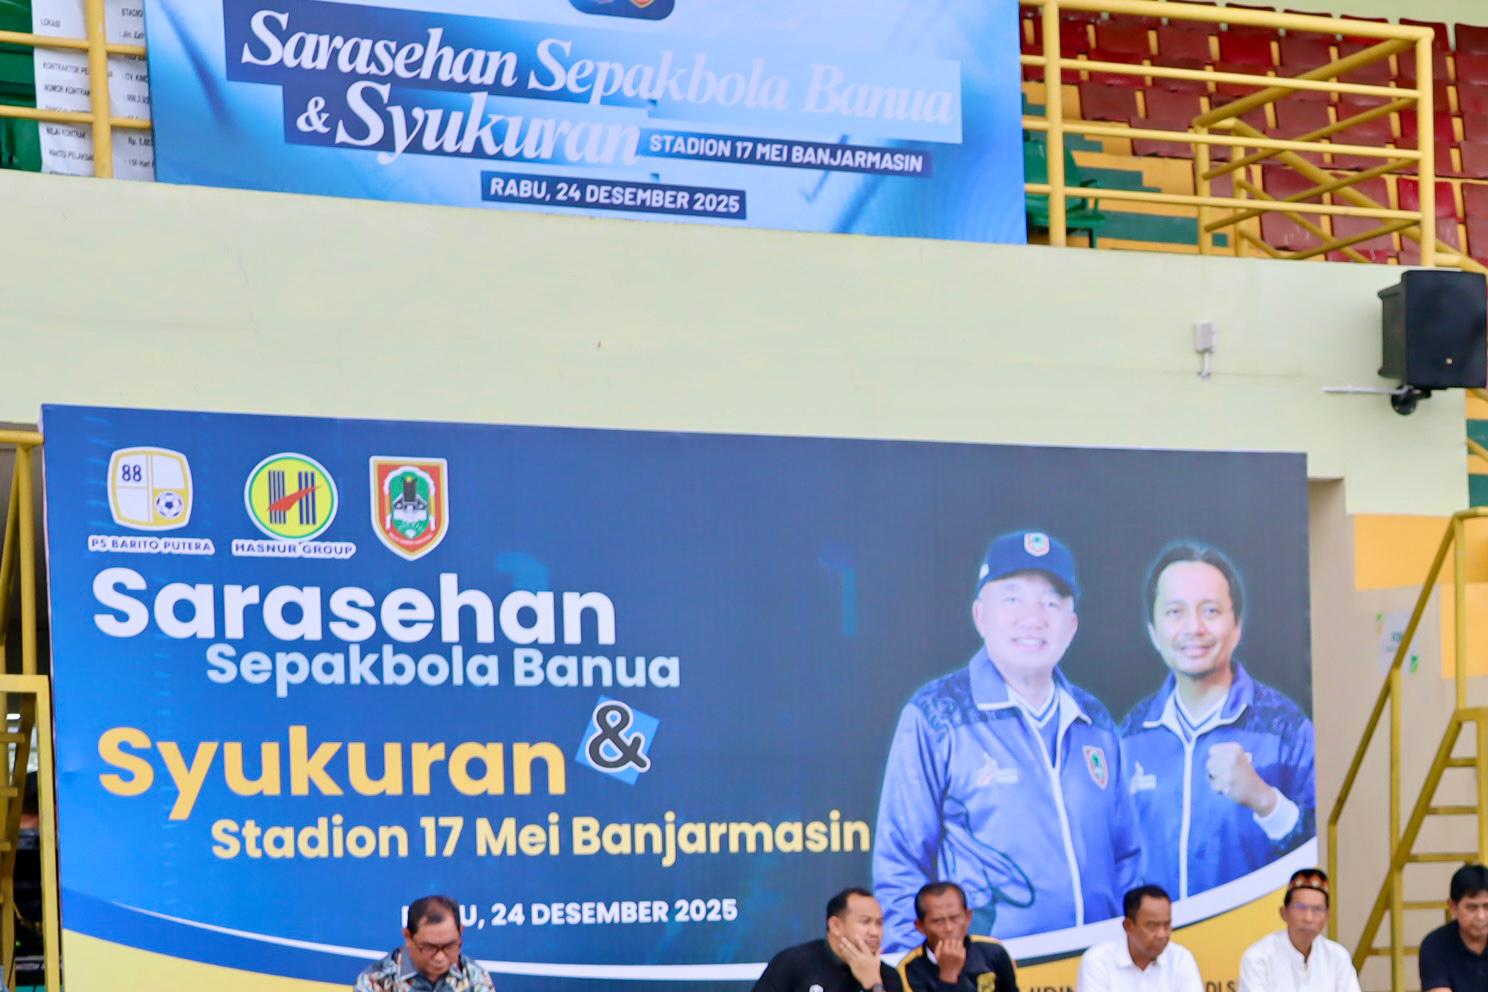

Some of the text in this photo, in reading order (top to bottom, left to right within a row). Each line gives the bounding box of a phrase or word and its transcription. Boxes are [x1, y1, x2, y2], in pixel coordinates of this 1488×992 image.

[242, 9, 955, 126] Sarasehan Sepakbola Banua
[296, 80, 641, 166] & Syukuran
[650, 133, 923, 173] STADION 17 MEI BANJARMASIN
[490, 177, 740, 212] RABU, 24 DESEMBER 2025
[121, 464, 142, 482] 88
[91, 537, 211, 553] PS BARITO PUTERA
[235, 542, 353, 556] HASNUR GROUP
[93, 567, 616, 645] Sarasehan
[206, 643, 680, 698] Sepakbola Banua
[587, 702, 649, 771] &
[98, 724, 566, 820] Syukuran
[211, 809, 871, 867] Stadion 17 Mei Banjarmasin
[492, 905, 526, 925] 24
[532, 902, 669, 925] DESEMBER
[676, 900, 738, 922] 2025
